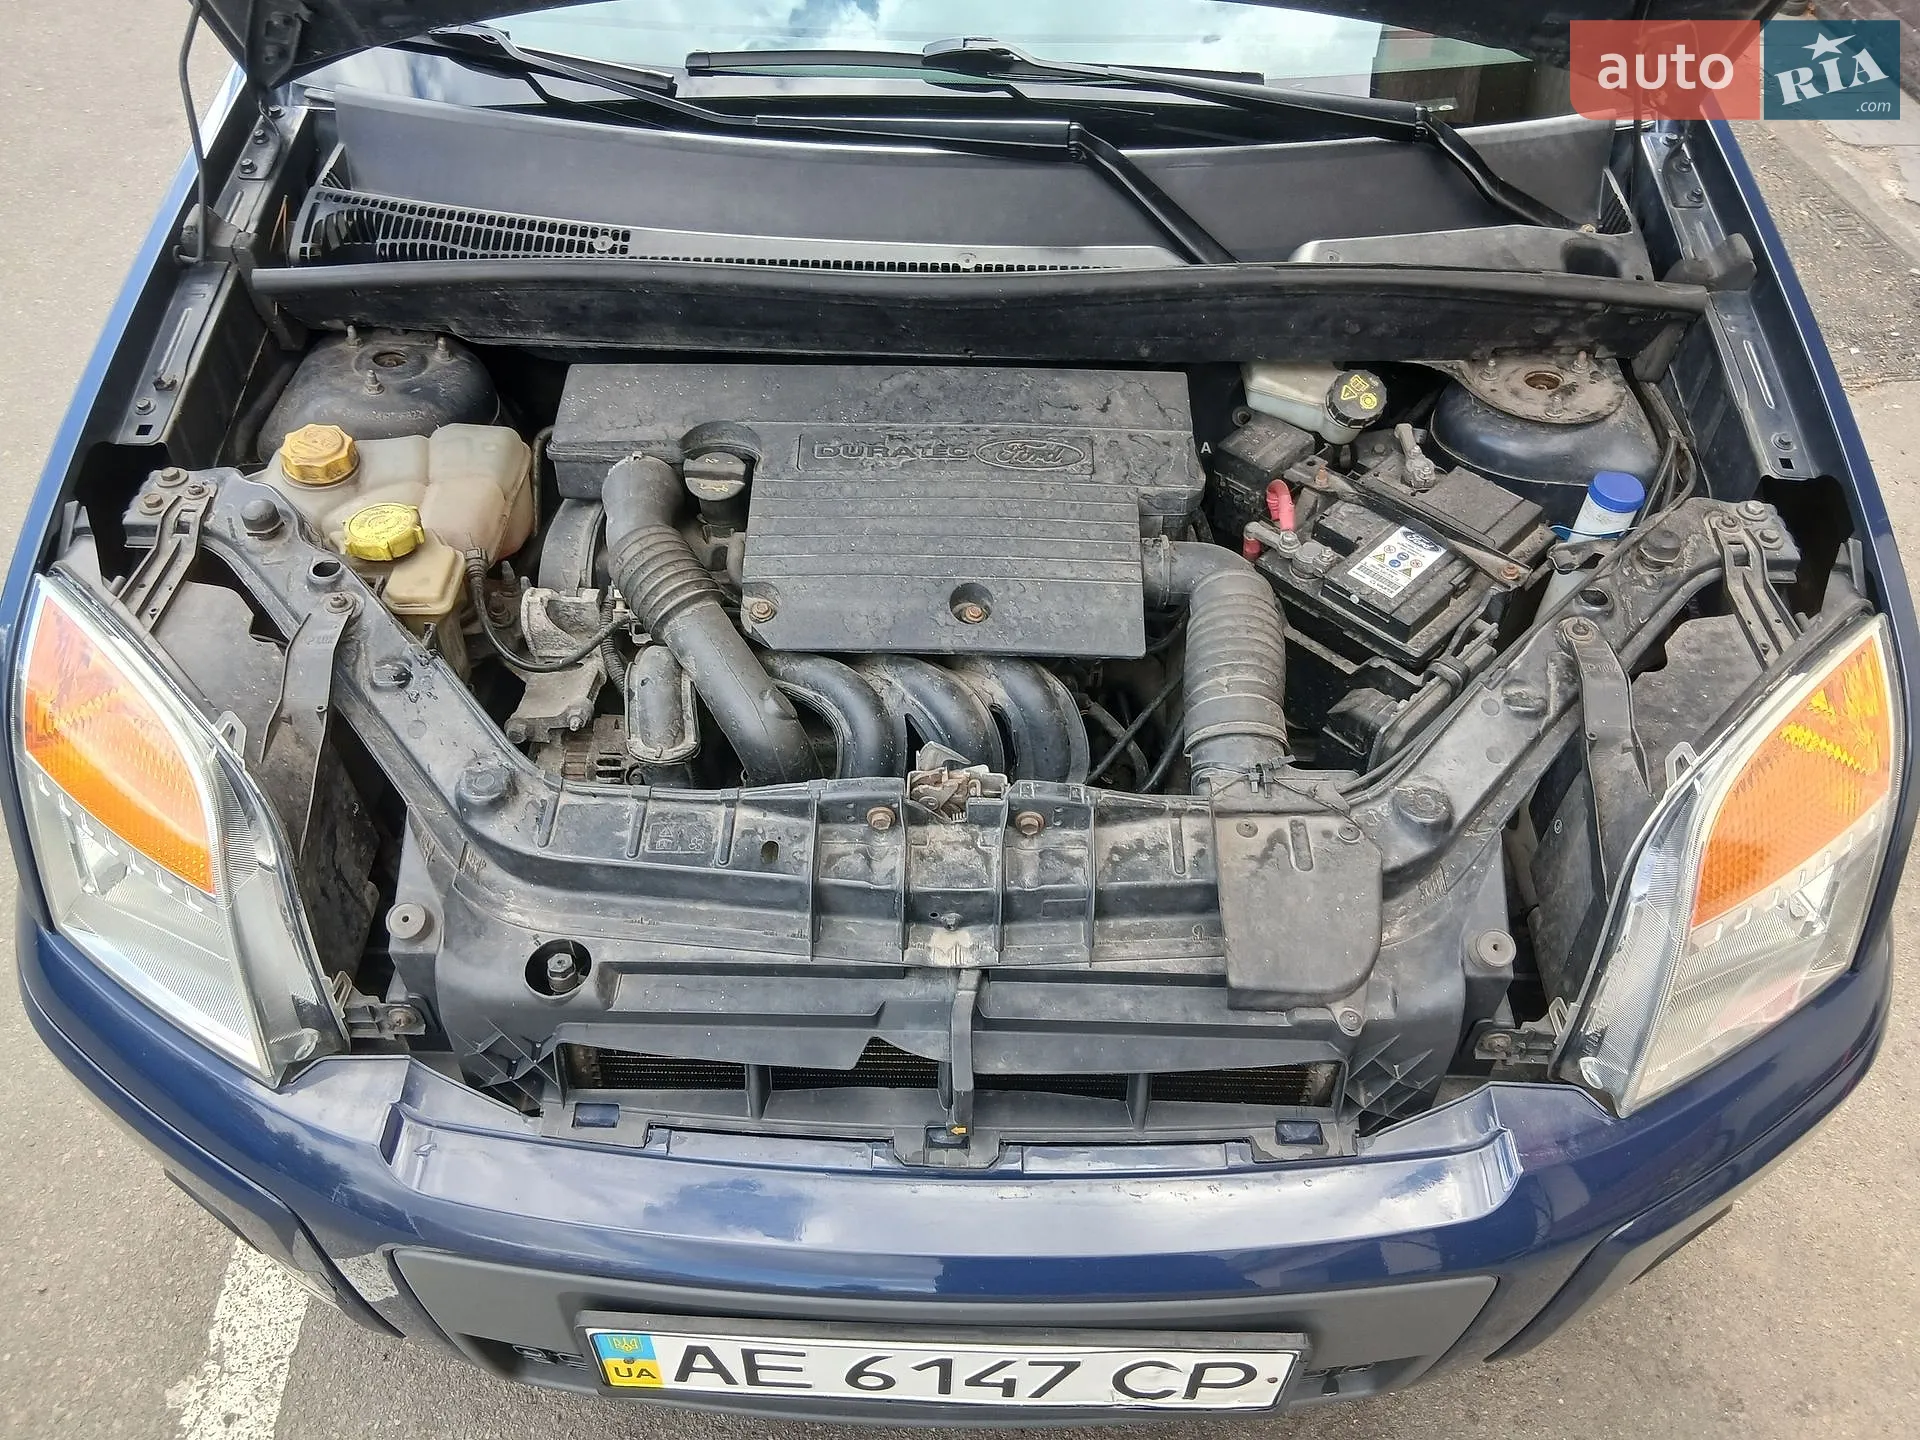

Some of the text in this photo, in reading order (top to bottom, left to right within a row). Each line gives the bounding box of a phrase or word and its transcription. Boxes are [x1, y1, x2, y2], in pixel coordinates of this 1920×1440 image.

[814, 442, 969, 461] DURATEC
[992, 440, 1068, 466] Ford
[1406, 532, 1437, 550] Ford
[614, 1366, 656, 1379] UA
[674, 1345, 1258, 1400] AE 6147 CP
